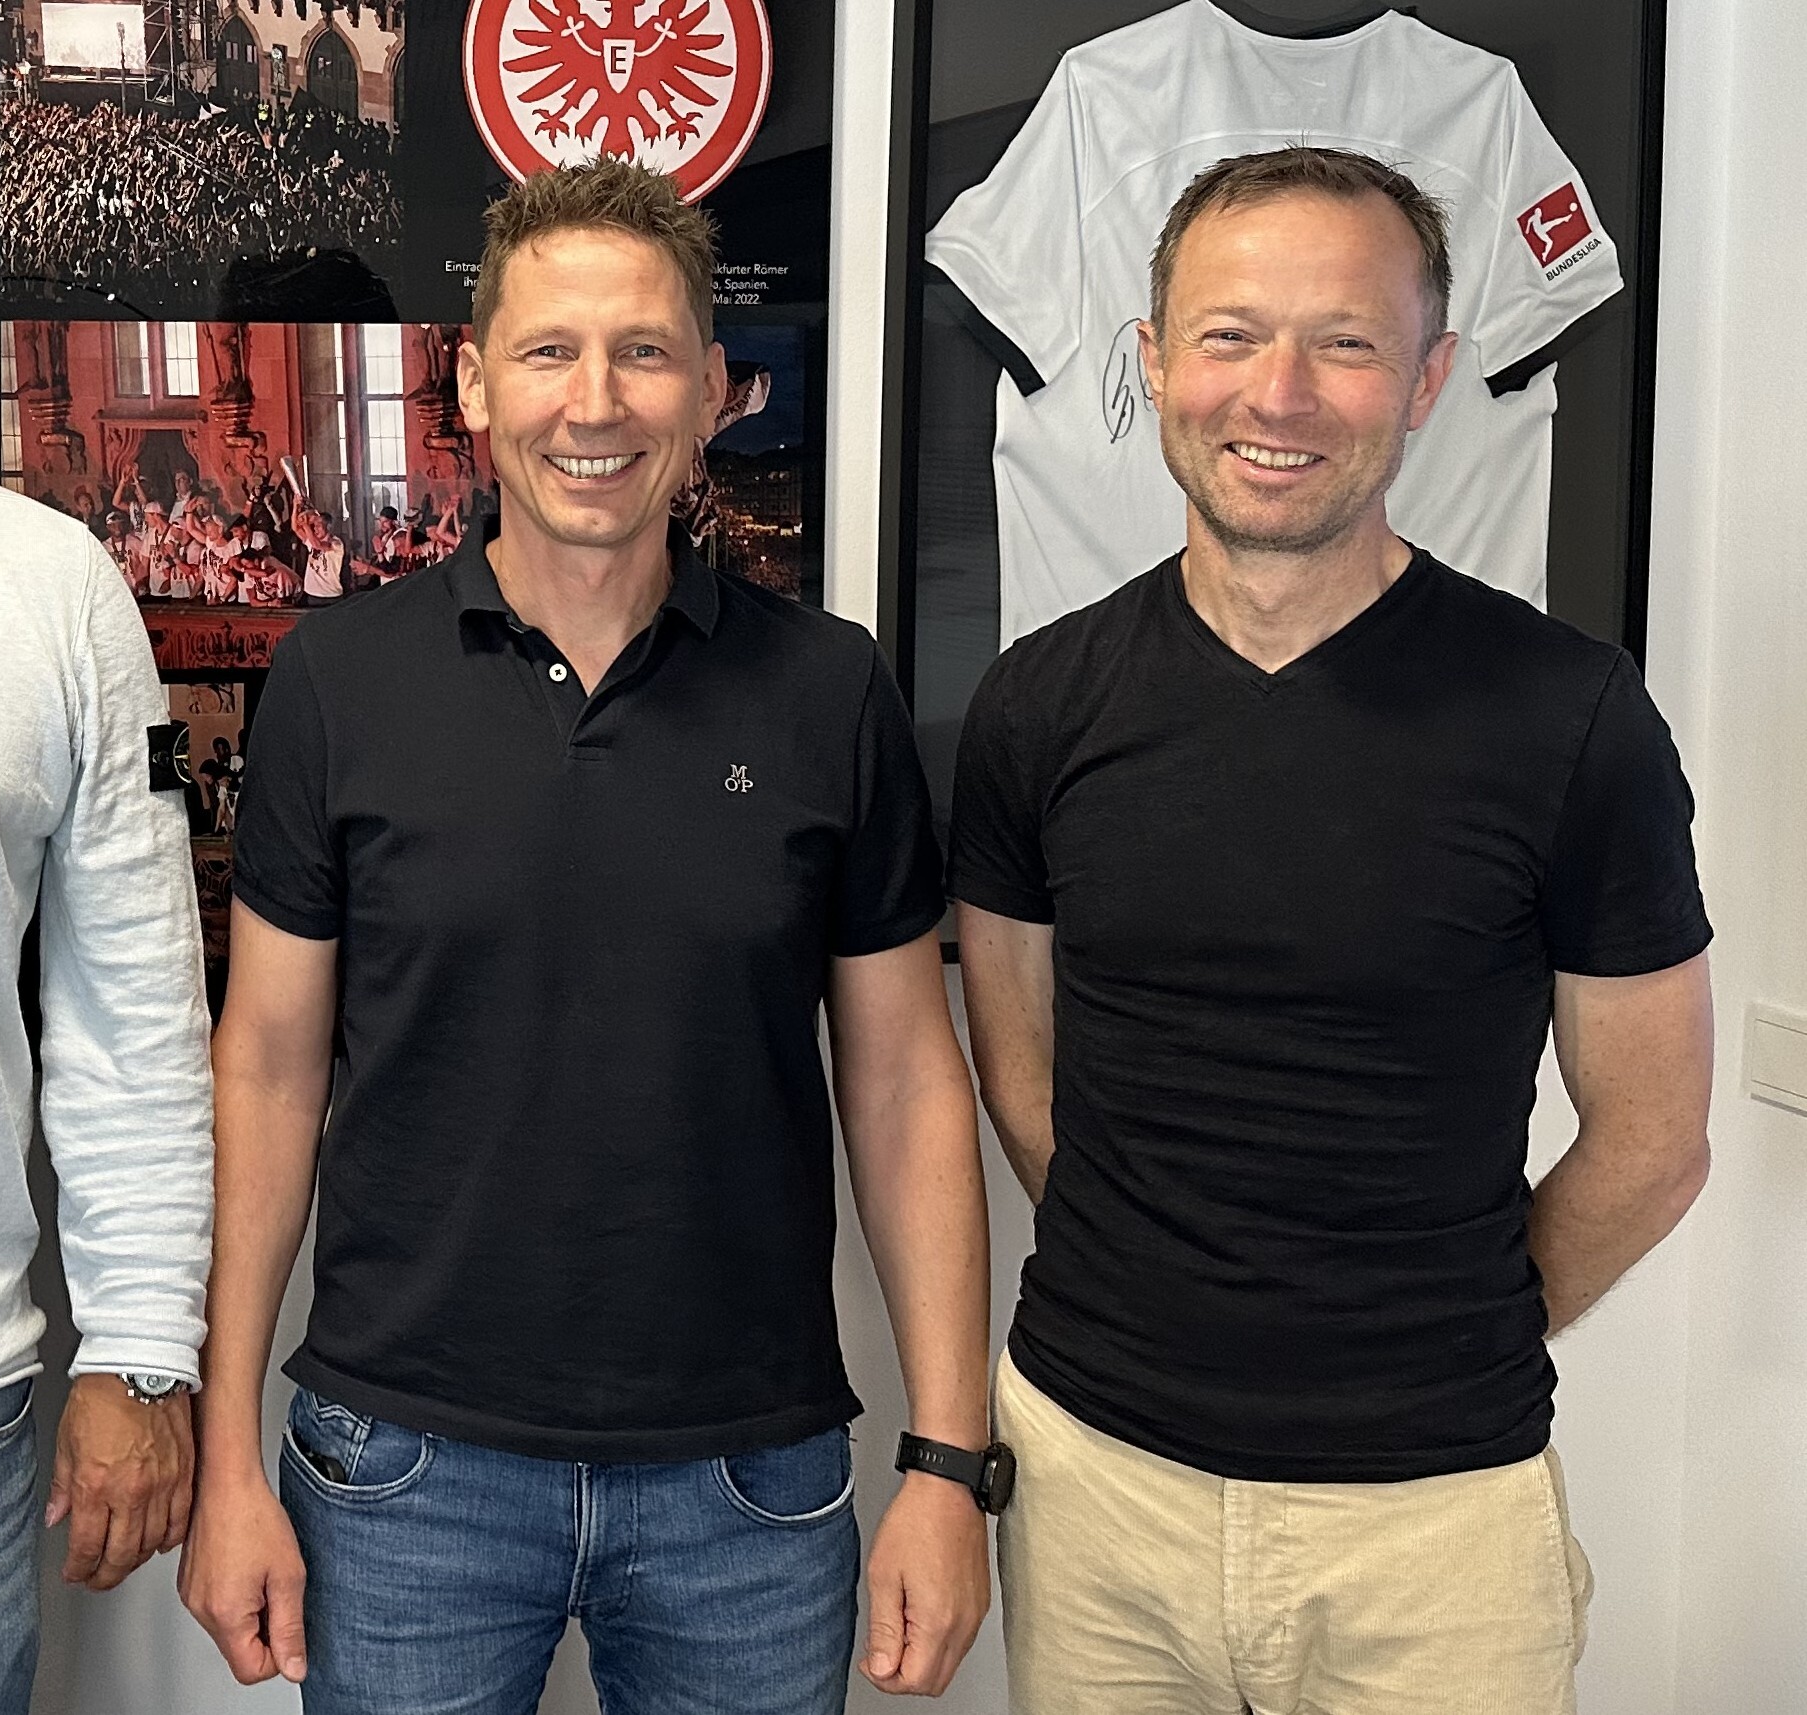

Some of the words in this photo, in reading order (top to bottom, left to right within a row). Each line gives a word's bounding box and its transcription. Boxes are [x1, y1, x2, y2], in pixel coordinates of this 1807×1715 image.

[610, 46, 627, 74] E
[754, 263, 789, 275] Römer
[1545, 238, 1602, 281] BUNDESLIGA
